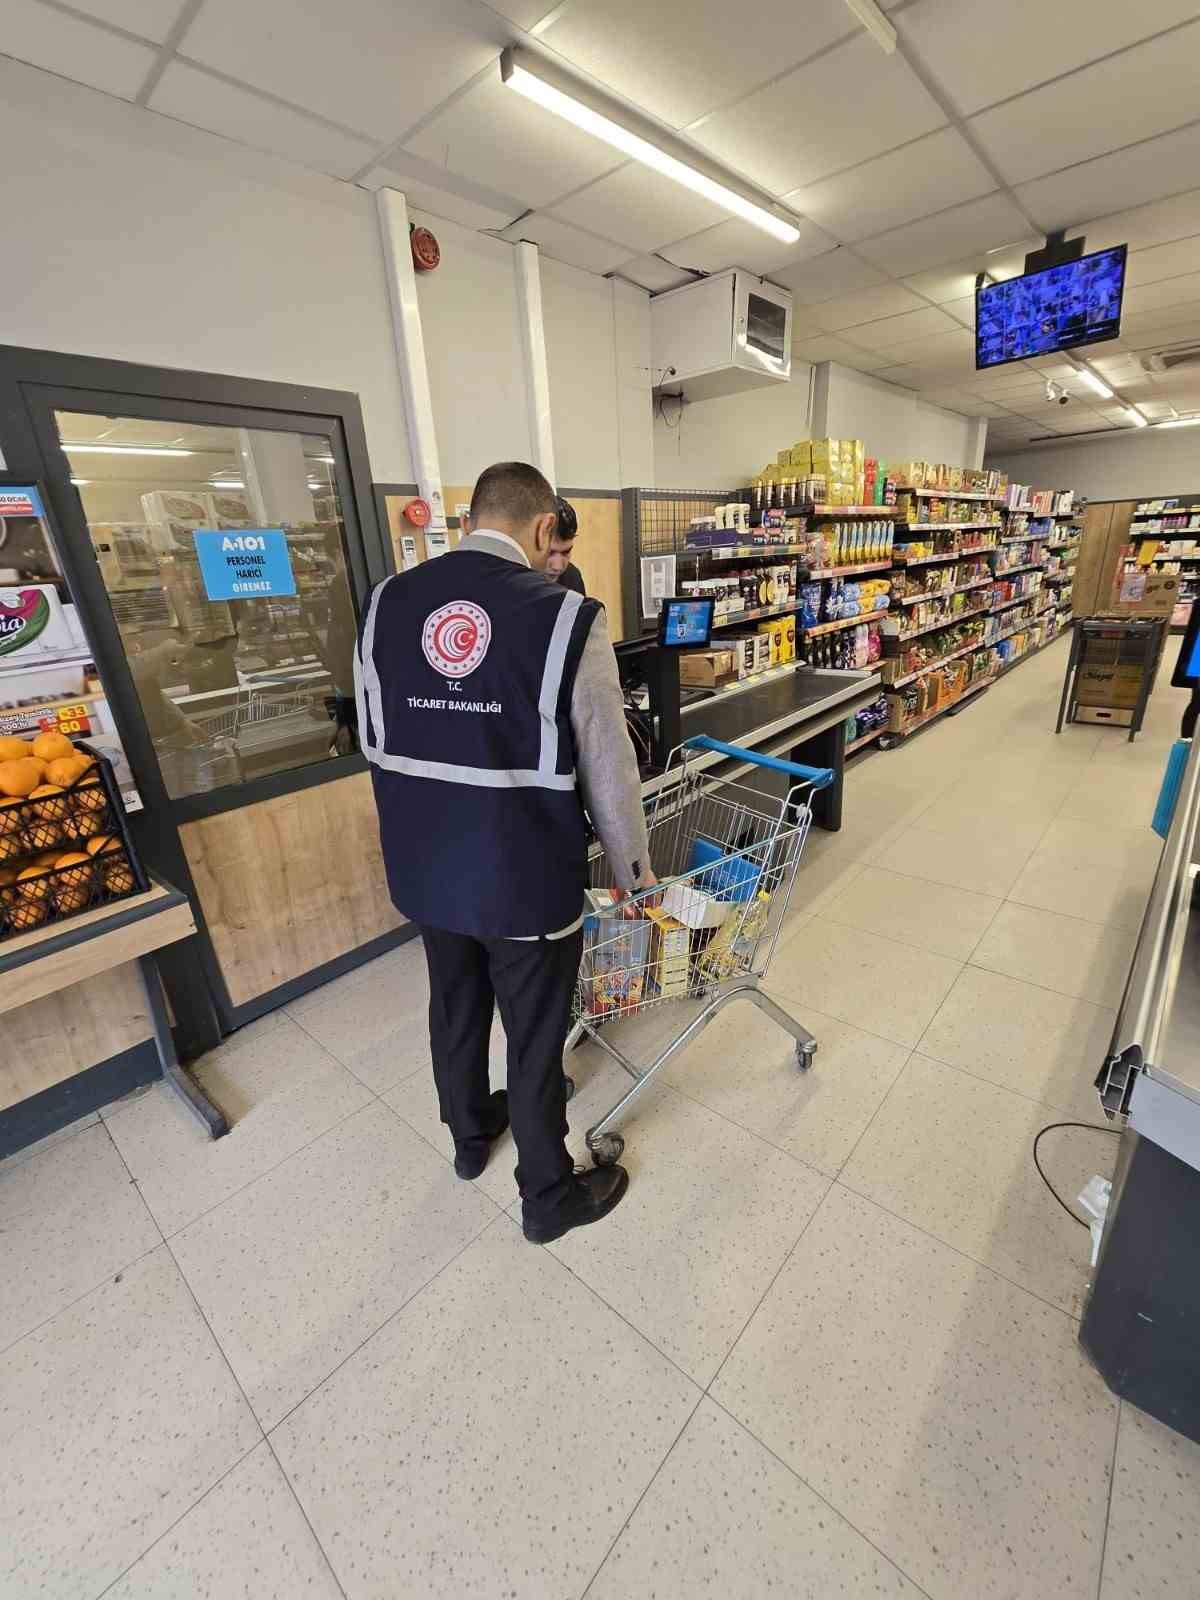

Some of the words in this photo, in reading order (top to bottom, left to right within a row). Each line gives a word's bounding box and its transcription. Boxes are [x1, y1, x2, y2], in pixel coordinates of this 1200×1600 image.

[226, 555, 266, 566] PERSONEL
[407, 696, 447, 710] TİCARET
[448, 701, 502, 714] BAKANLIĞI
